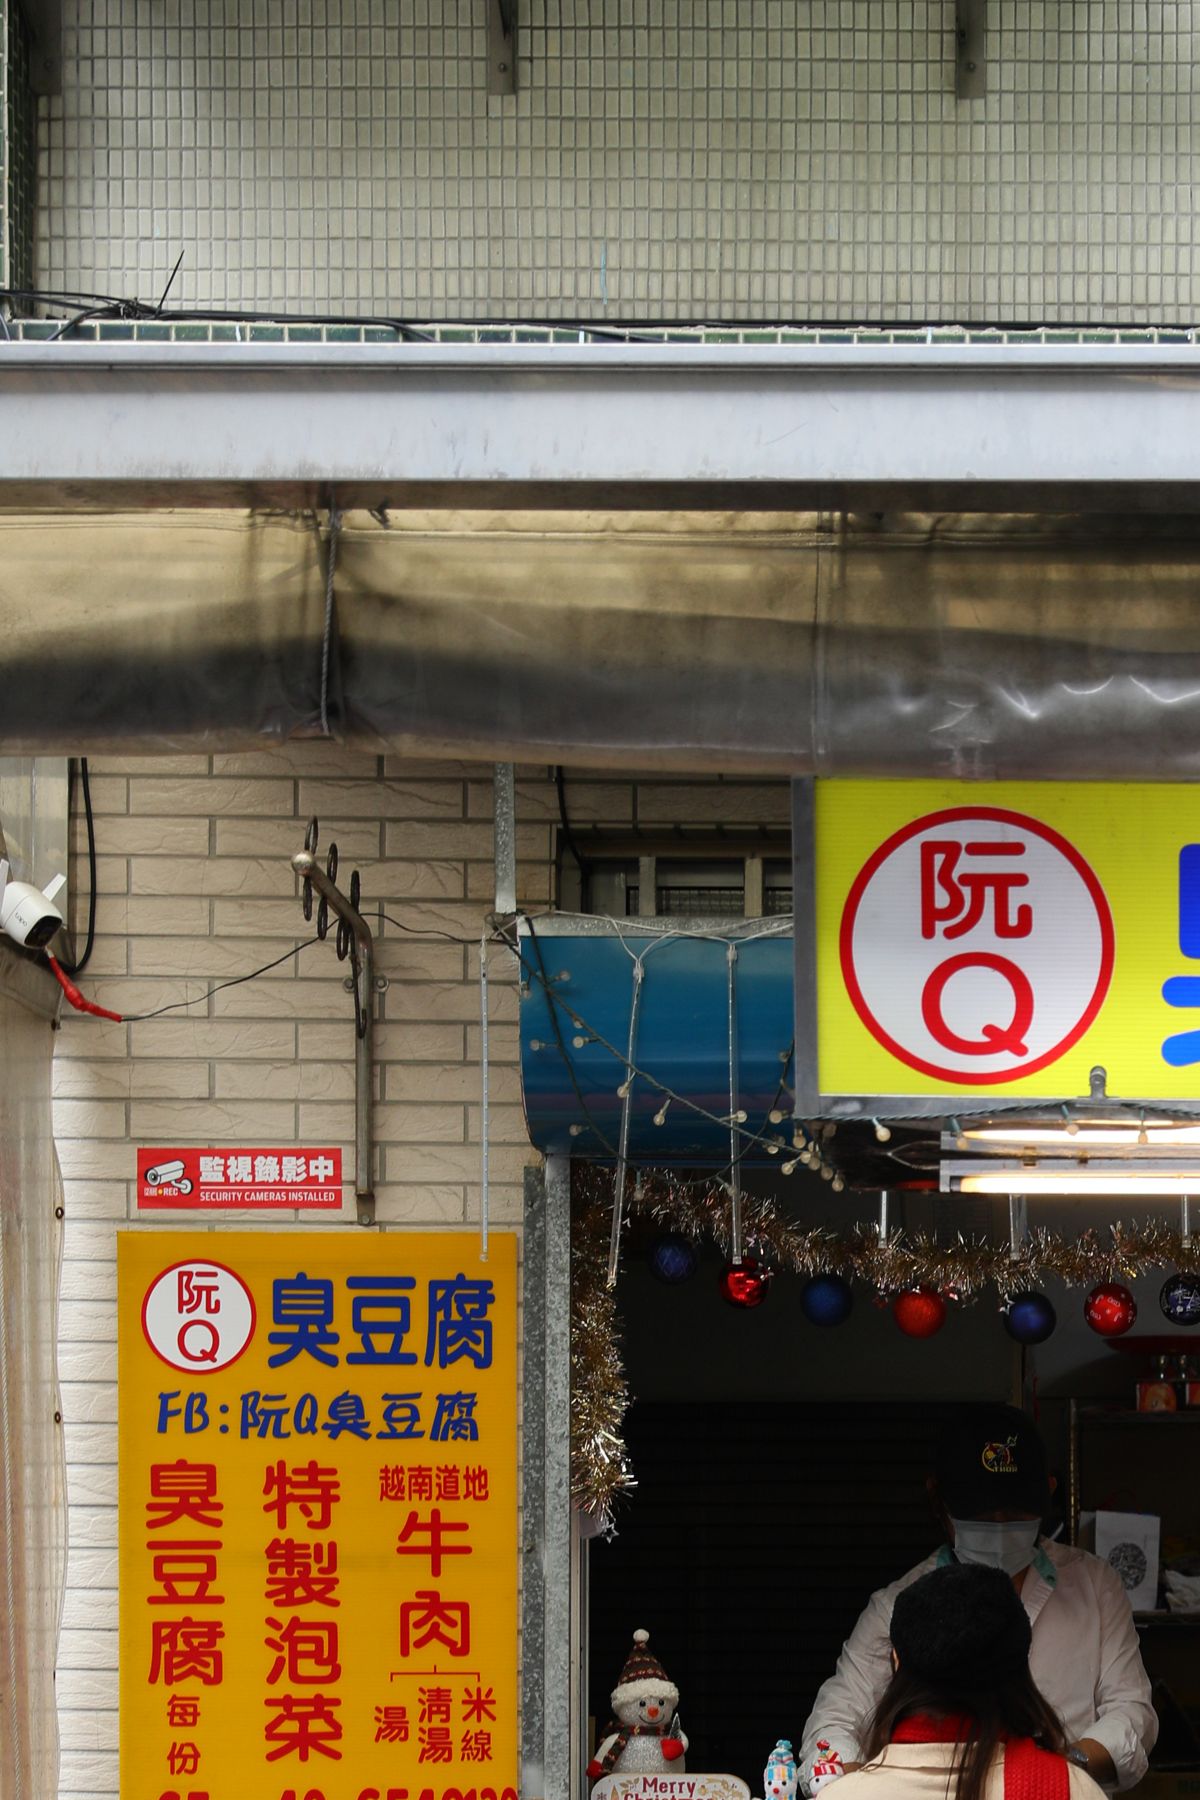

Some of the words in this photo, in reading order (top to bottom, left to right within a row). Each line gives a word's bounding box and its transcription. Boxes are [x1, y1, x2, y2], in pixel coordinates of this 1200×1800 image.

[921, 840, 1034, 1057] 阮Q
[163, 1187, 178, 1196] REC
[200, 1155, 334, 1183] 監視錄影中
[200, 1191, 242, 1202] SECURITY
[244, 1191, 287, 1202] CAMERAS
[288, 1191, 335, 1202] INSTALLED
[177, 1271, 220, 1363] 阮Q
[267, 1272, 496, 1369] 臭豆腐
[379, 1464, 490, 1502] 越南道地
[146, 1458, 225, 1686] 臭豆腐
[263, 1460, 343, 1763] 特製泡菜
[396, 1508, 473, 1658] 牛肉
[167, 1694, 201, 1776] 每份
[374, 1706, 410, 1743] 湯
[460, 1687, 498, 1763] 米線
[641, 1776, 697, 1797] Merry
